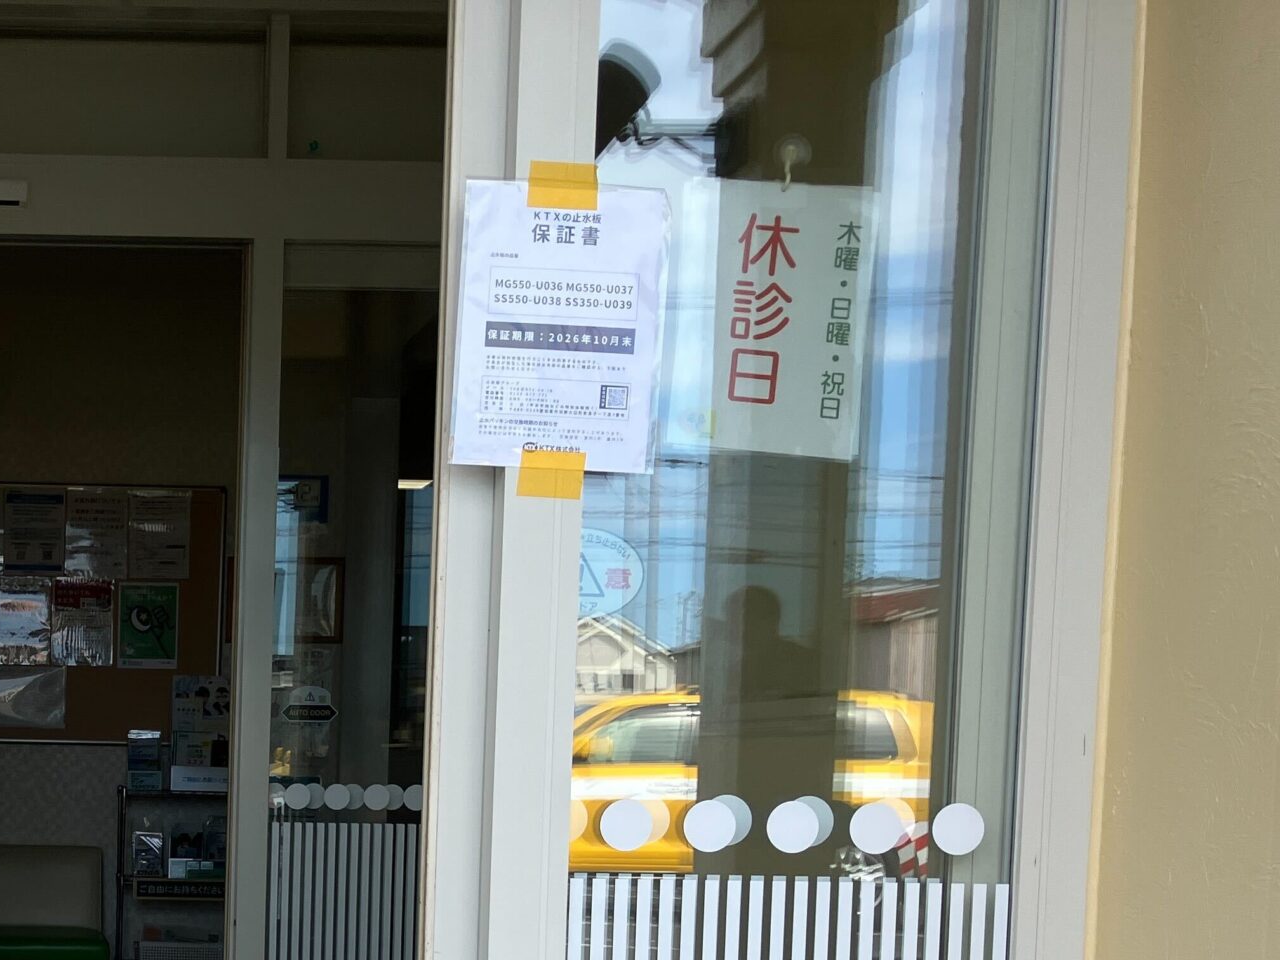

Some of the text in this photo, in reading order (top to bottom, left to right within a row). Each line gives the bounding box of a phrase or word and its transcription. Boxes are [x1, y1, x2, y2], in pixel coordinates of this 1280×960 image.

[531, 223, 600, 246] 保証書
[495, 279, 634, 295] MG550-U036 MG550-U037
[494, 294, 633, 310] SS550-U038 SS350-U039
[728, 213, 800, 405] 休診日
[820, 221, 863, 420] 木曜・日曜・祝日
